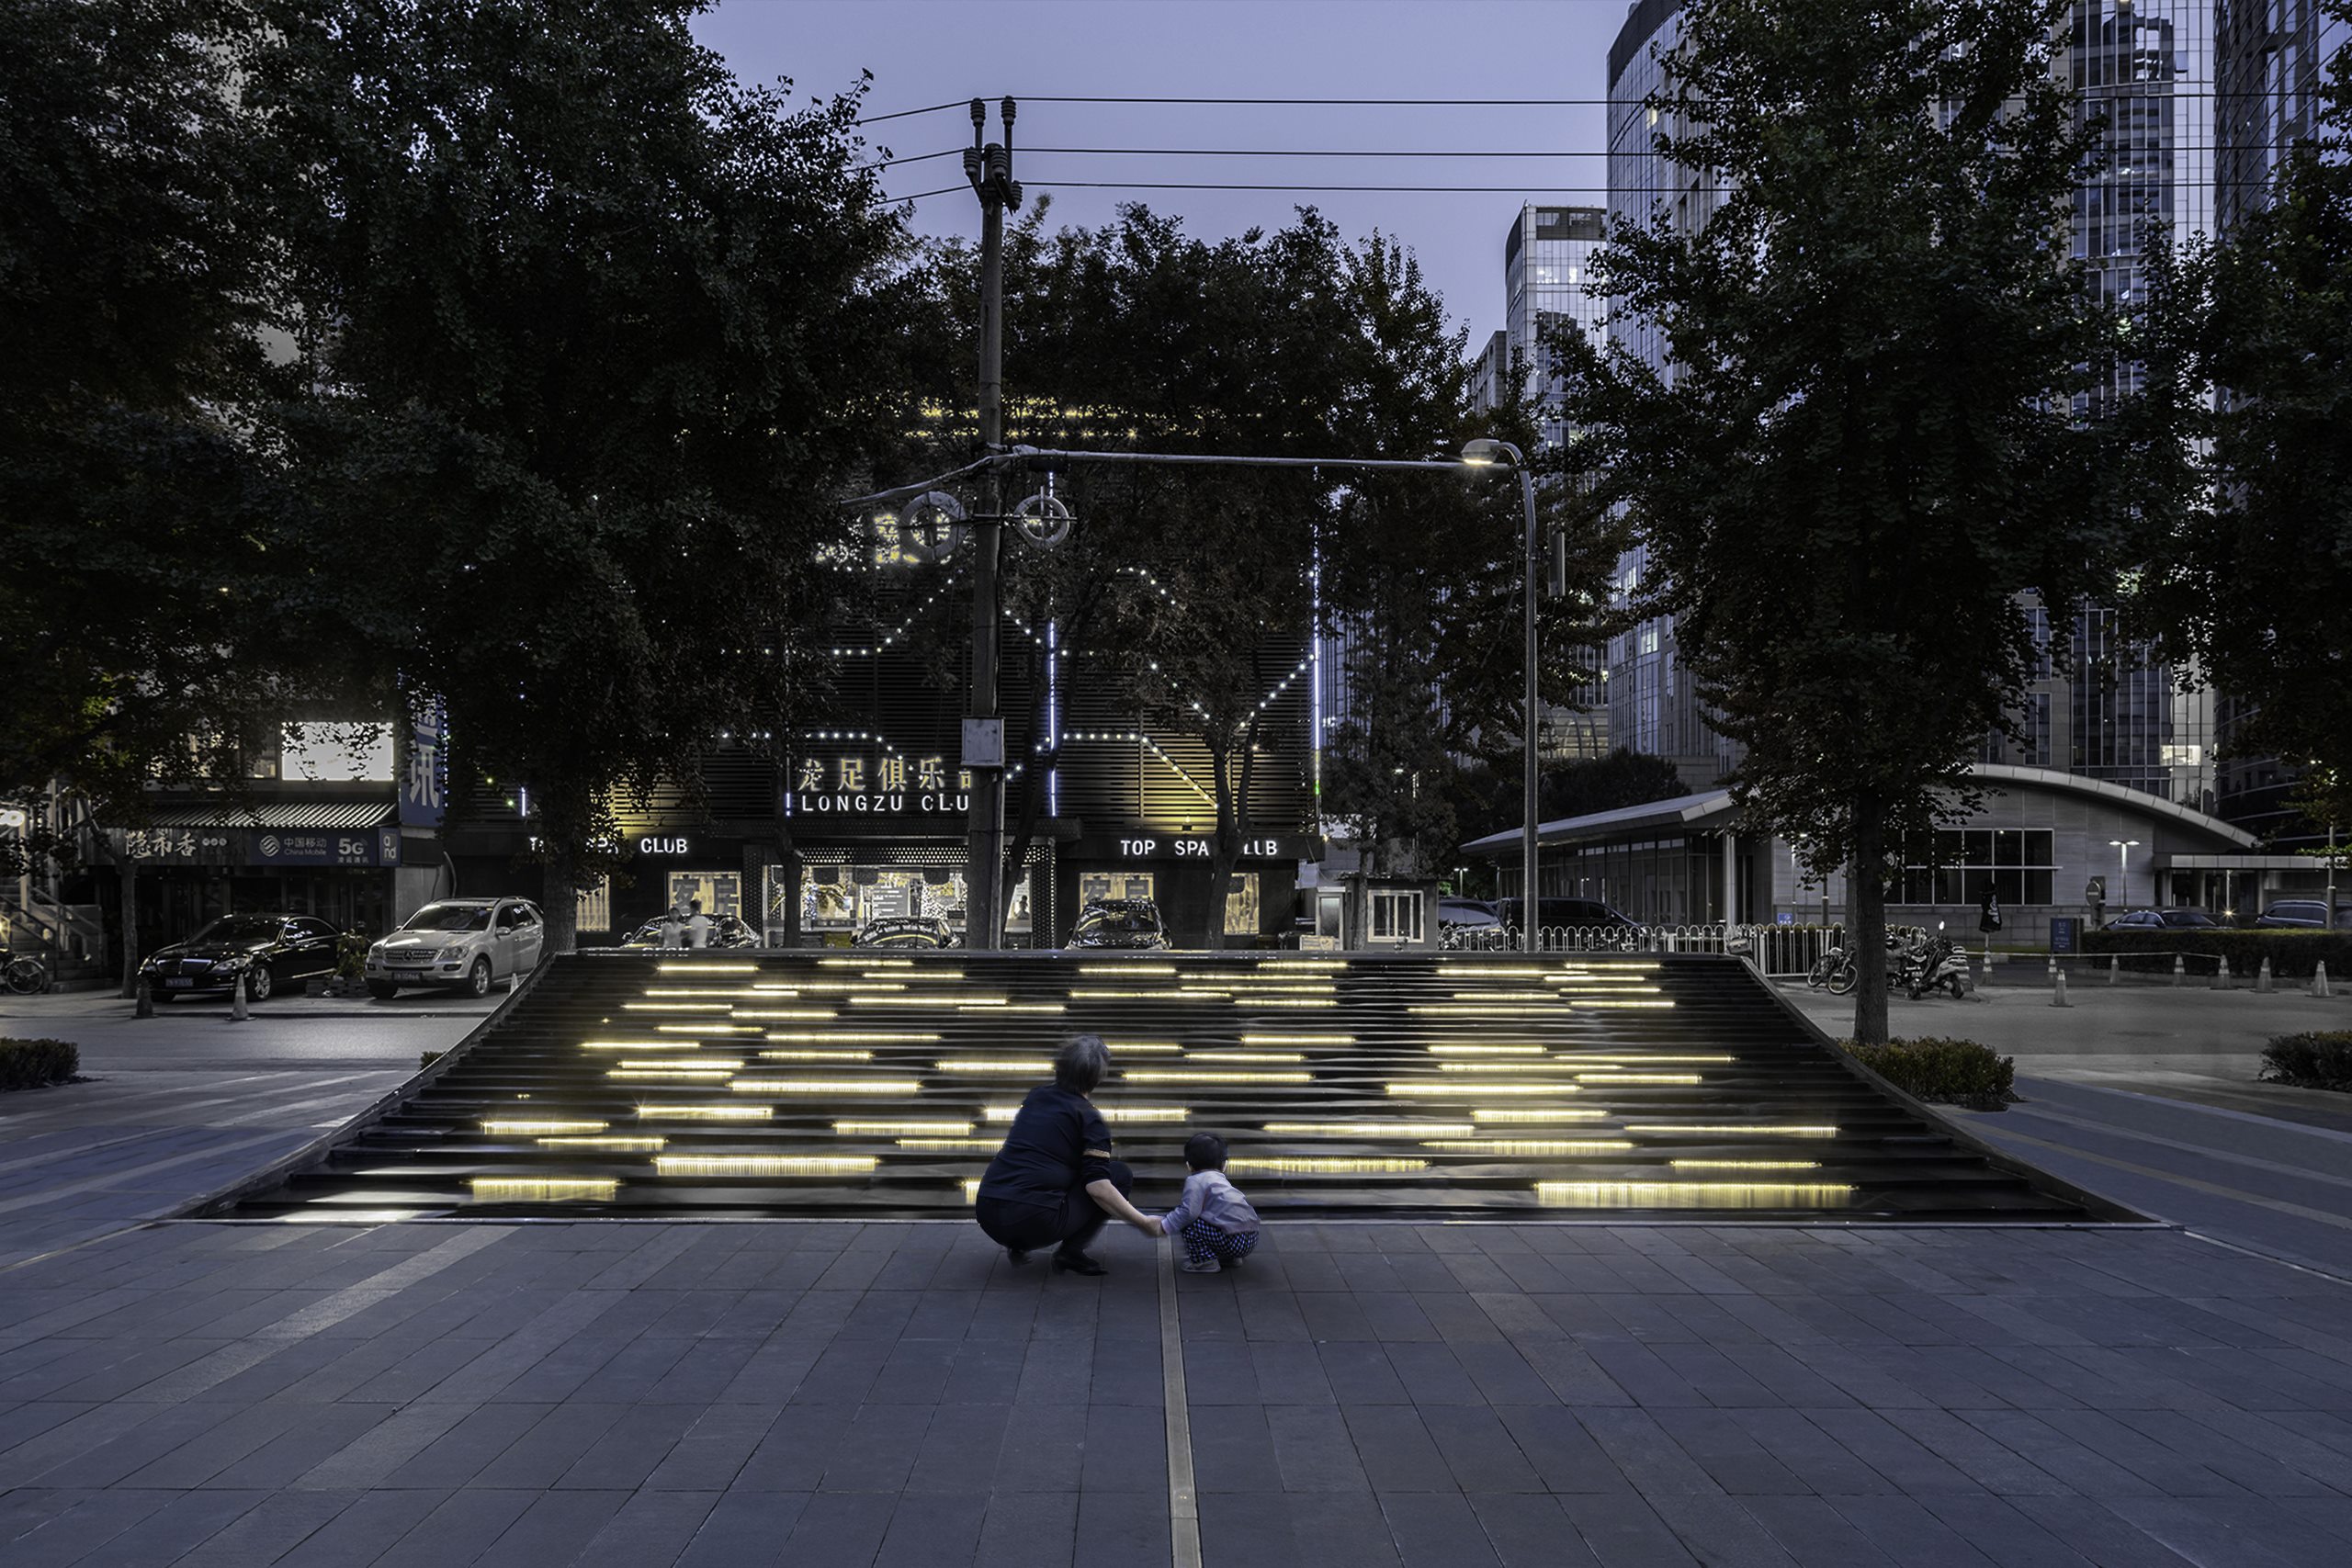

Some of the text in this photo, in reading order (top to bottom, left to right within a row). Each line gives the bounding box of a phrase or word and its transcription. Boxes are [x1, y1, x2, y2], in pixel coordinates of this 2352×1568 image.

[802, 795, 970, 812] LONGZU CLU
[283, 837, 327, 848] 中国移动
[338, 838, 364, 855] 5G
[640, 837, 688, 854] CLUB
[1120, 840, 1156, 856] TOP
[1174, 840, 1209, 856] SPA
[283, 848, 327, 856] China Mobile
